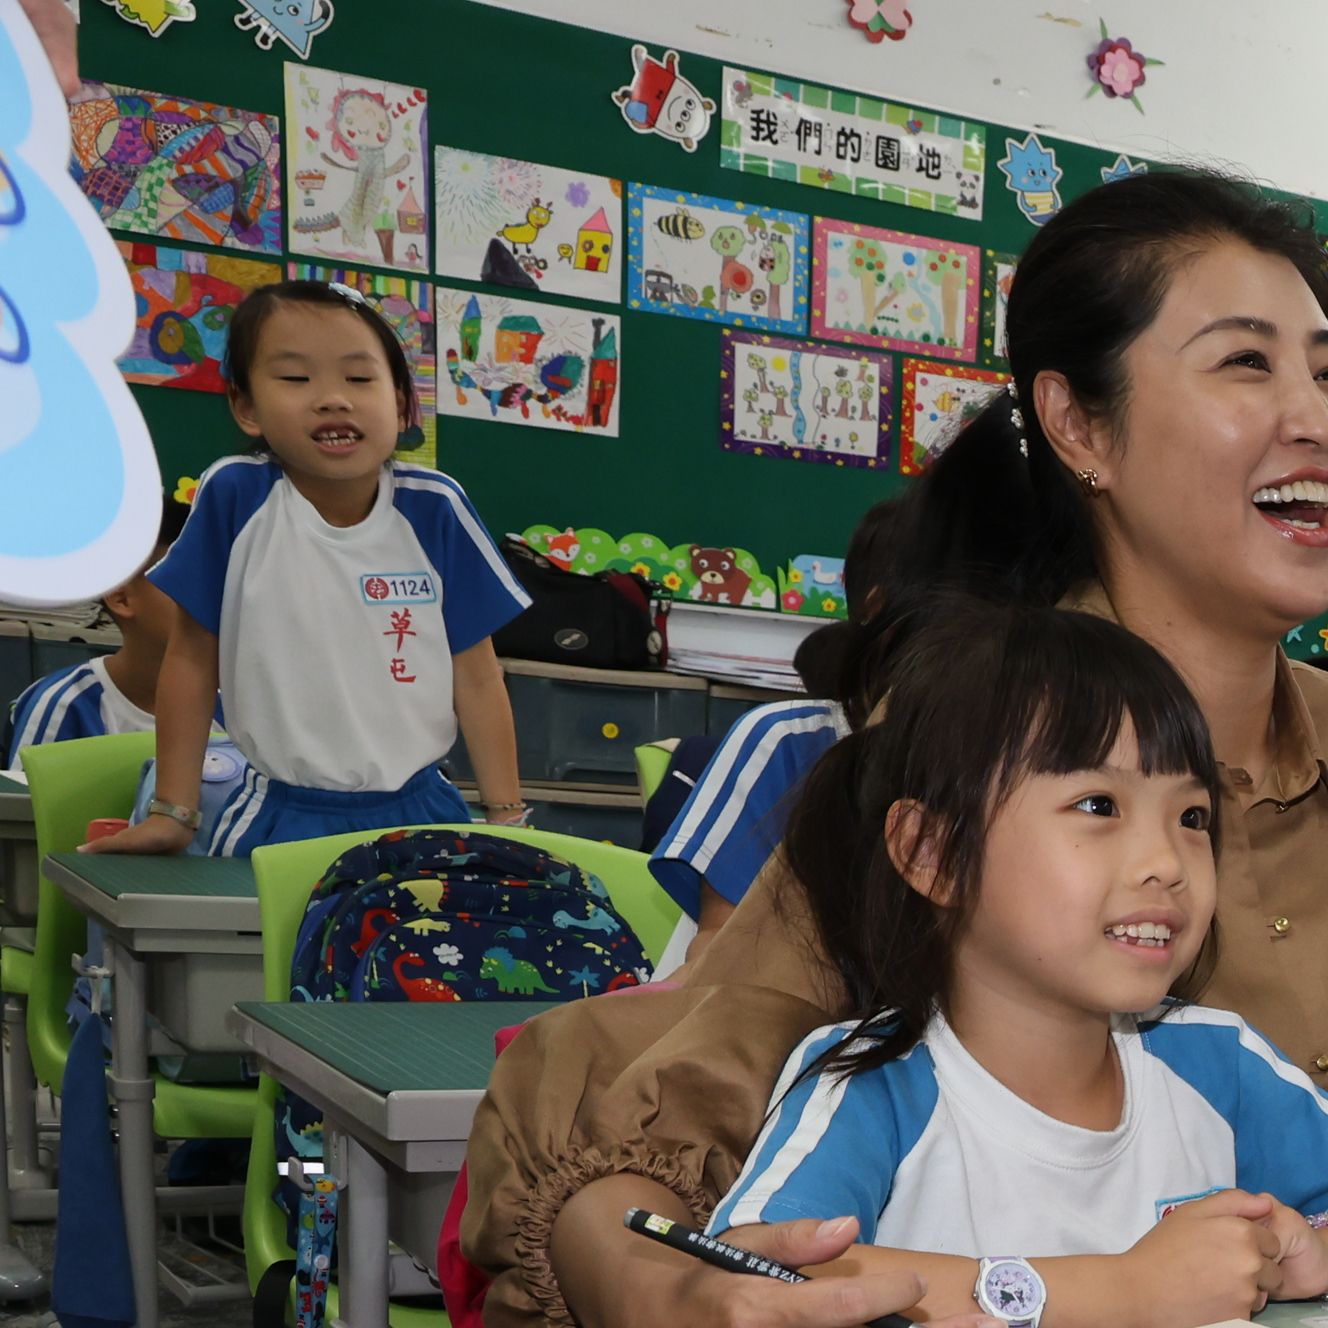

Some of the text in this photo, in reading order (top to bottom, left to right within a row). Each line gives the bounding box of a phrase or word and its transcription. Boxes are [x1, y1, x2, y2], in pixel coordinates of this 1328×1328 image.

[750, 108, 942, 181] 我們的園地
[390, 578, 431, 597] 1124
[383, 606, 417, 684] 草屯
